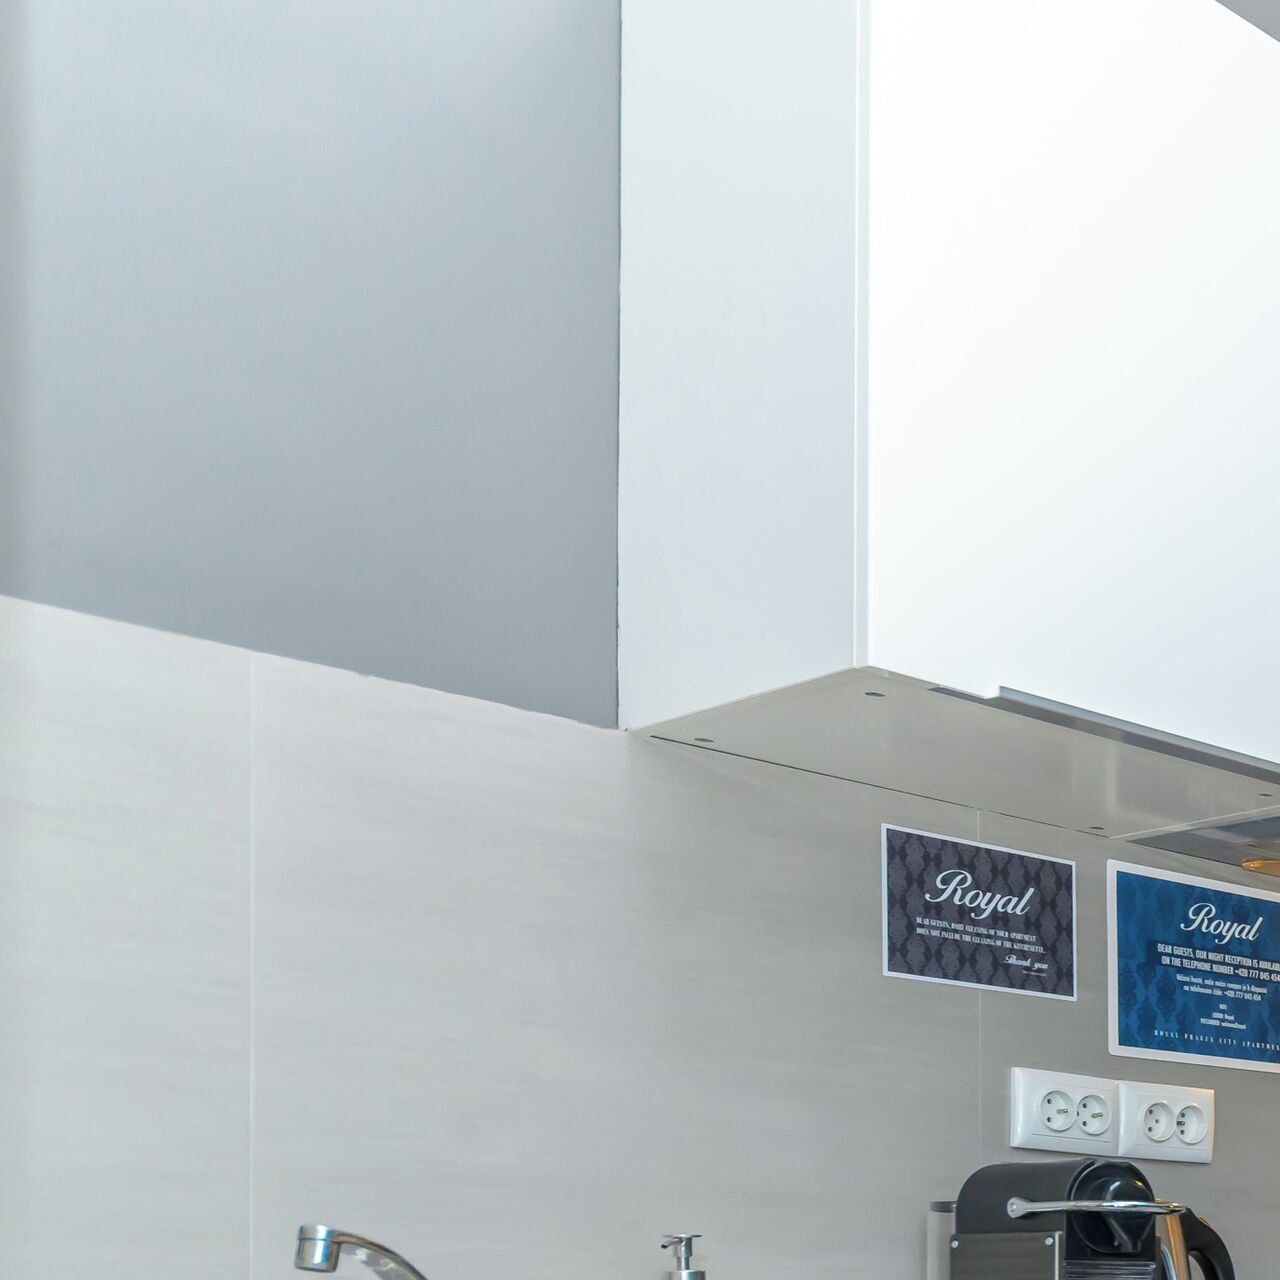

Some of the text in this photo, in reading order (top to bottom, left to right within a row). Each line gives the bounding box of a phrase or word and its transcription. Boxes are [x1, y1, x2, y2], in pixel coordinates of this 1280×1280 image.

[924, 869, 1034, 920] Royal
[1180, 902, 1264, 944] Royal
[1004, 954, 1048, 970] Thank you
[1157, 943, 1172, 954] DEAR
[1173, 946, 1195, 958] GUESTS,
[1196, 950, 1207, 959] OUR
[1208, 952, 1224, 962] NIGHT
[1225, 954, 1251, 966] RECEPTION
[1253, 959, 1258, 968] IS
[1161, 956, 1170, 964] ON
[1171, 957, 1181, 966] THE
[1182, 959, 1211, 971] TELEPHONE
[1213, 964, 1234, 975] NUMBER
[1235, 968, 1248, 977] +420
[1249, 969, 1258, 978] 777
[1271, 973, 1280, 982] 454
[1154, 1029, 1179, 1039] ROYAL
[1184, 1033, 1214, 1043] PRAGUE
[1219, 1037, 1237, 1046] CITY
